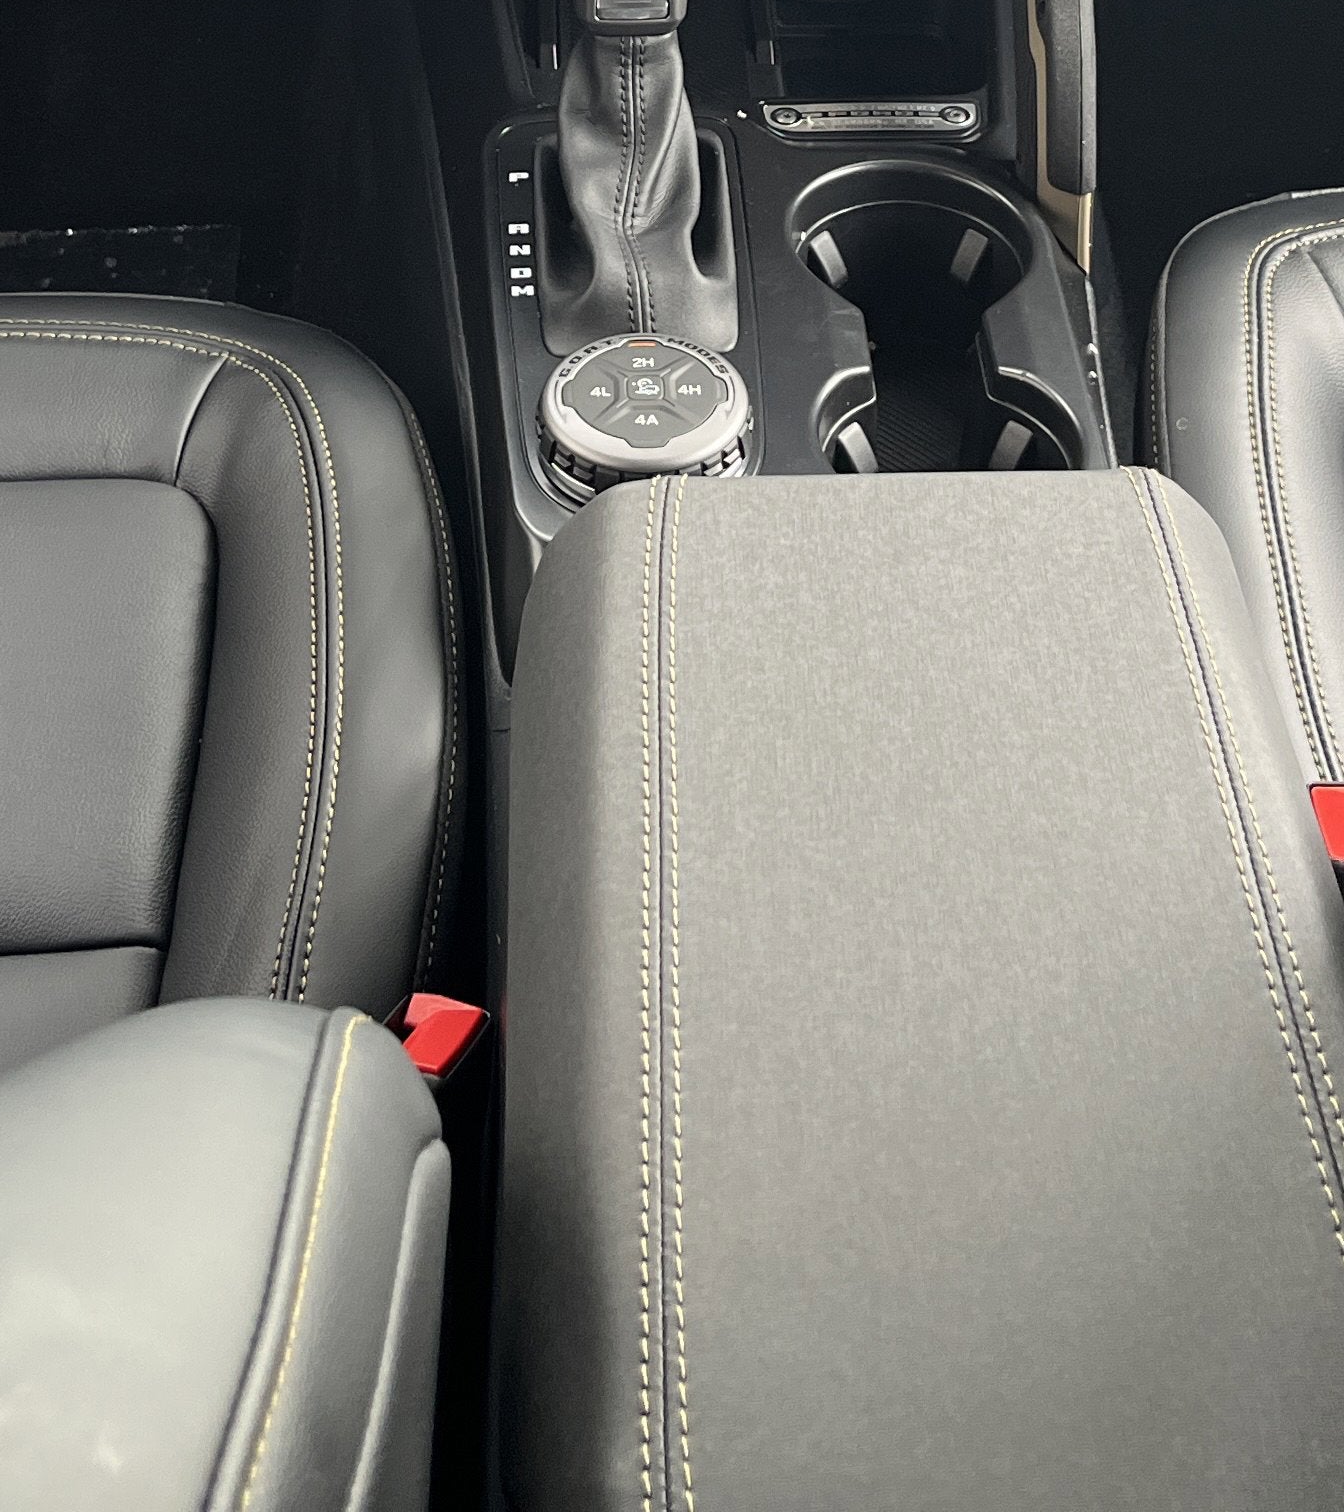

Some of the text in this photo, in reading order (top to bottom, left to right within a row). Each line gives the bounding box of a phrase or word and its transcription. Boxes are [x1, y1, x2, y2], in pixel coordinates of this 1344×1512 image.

[509, 244, 531, 256] N
[510, 267, 532, 279] D
[510, 285, 535, 297] M
[667, 338, 729, 374] MODES
[632, 357, 655, 368] 2H
[590, 387, 611, 397] 4L
[677, 384, 702, 395] 4H
[634, 414, 659, 425] 4A
